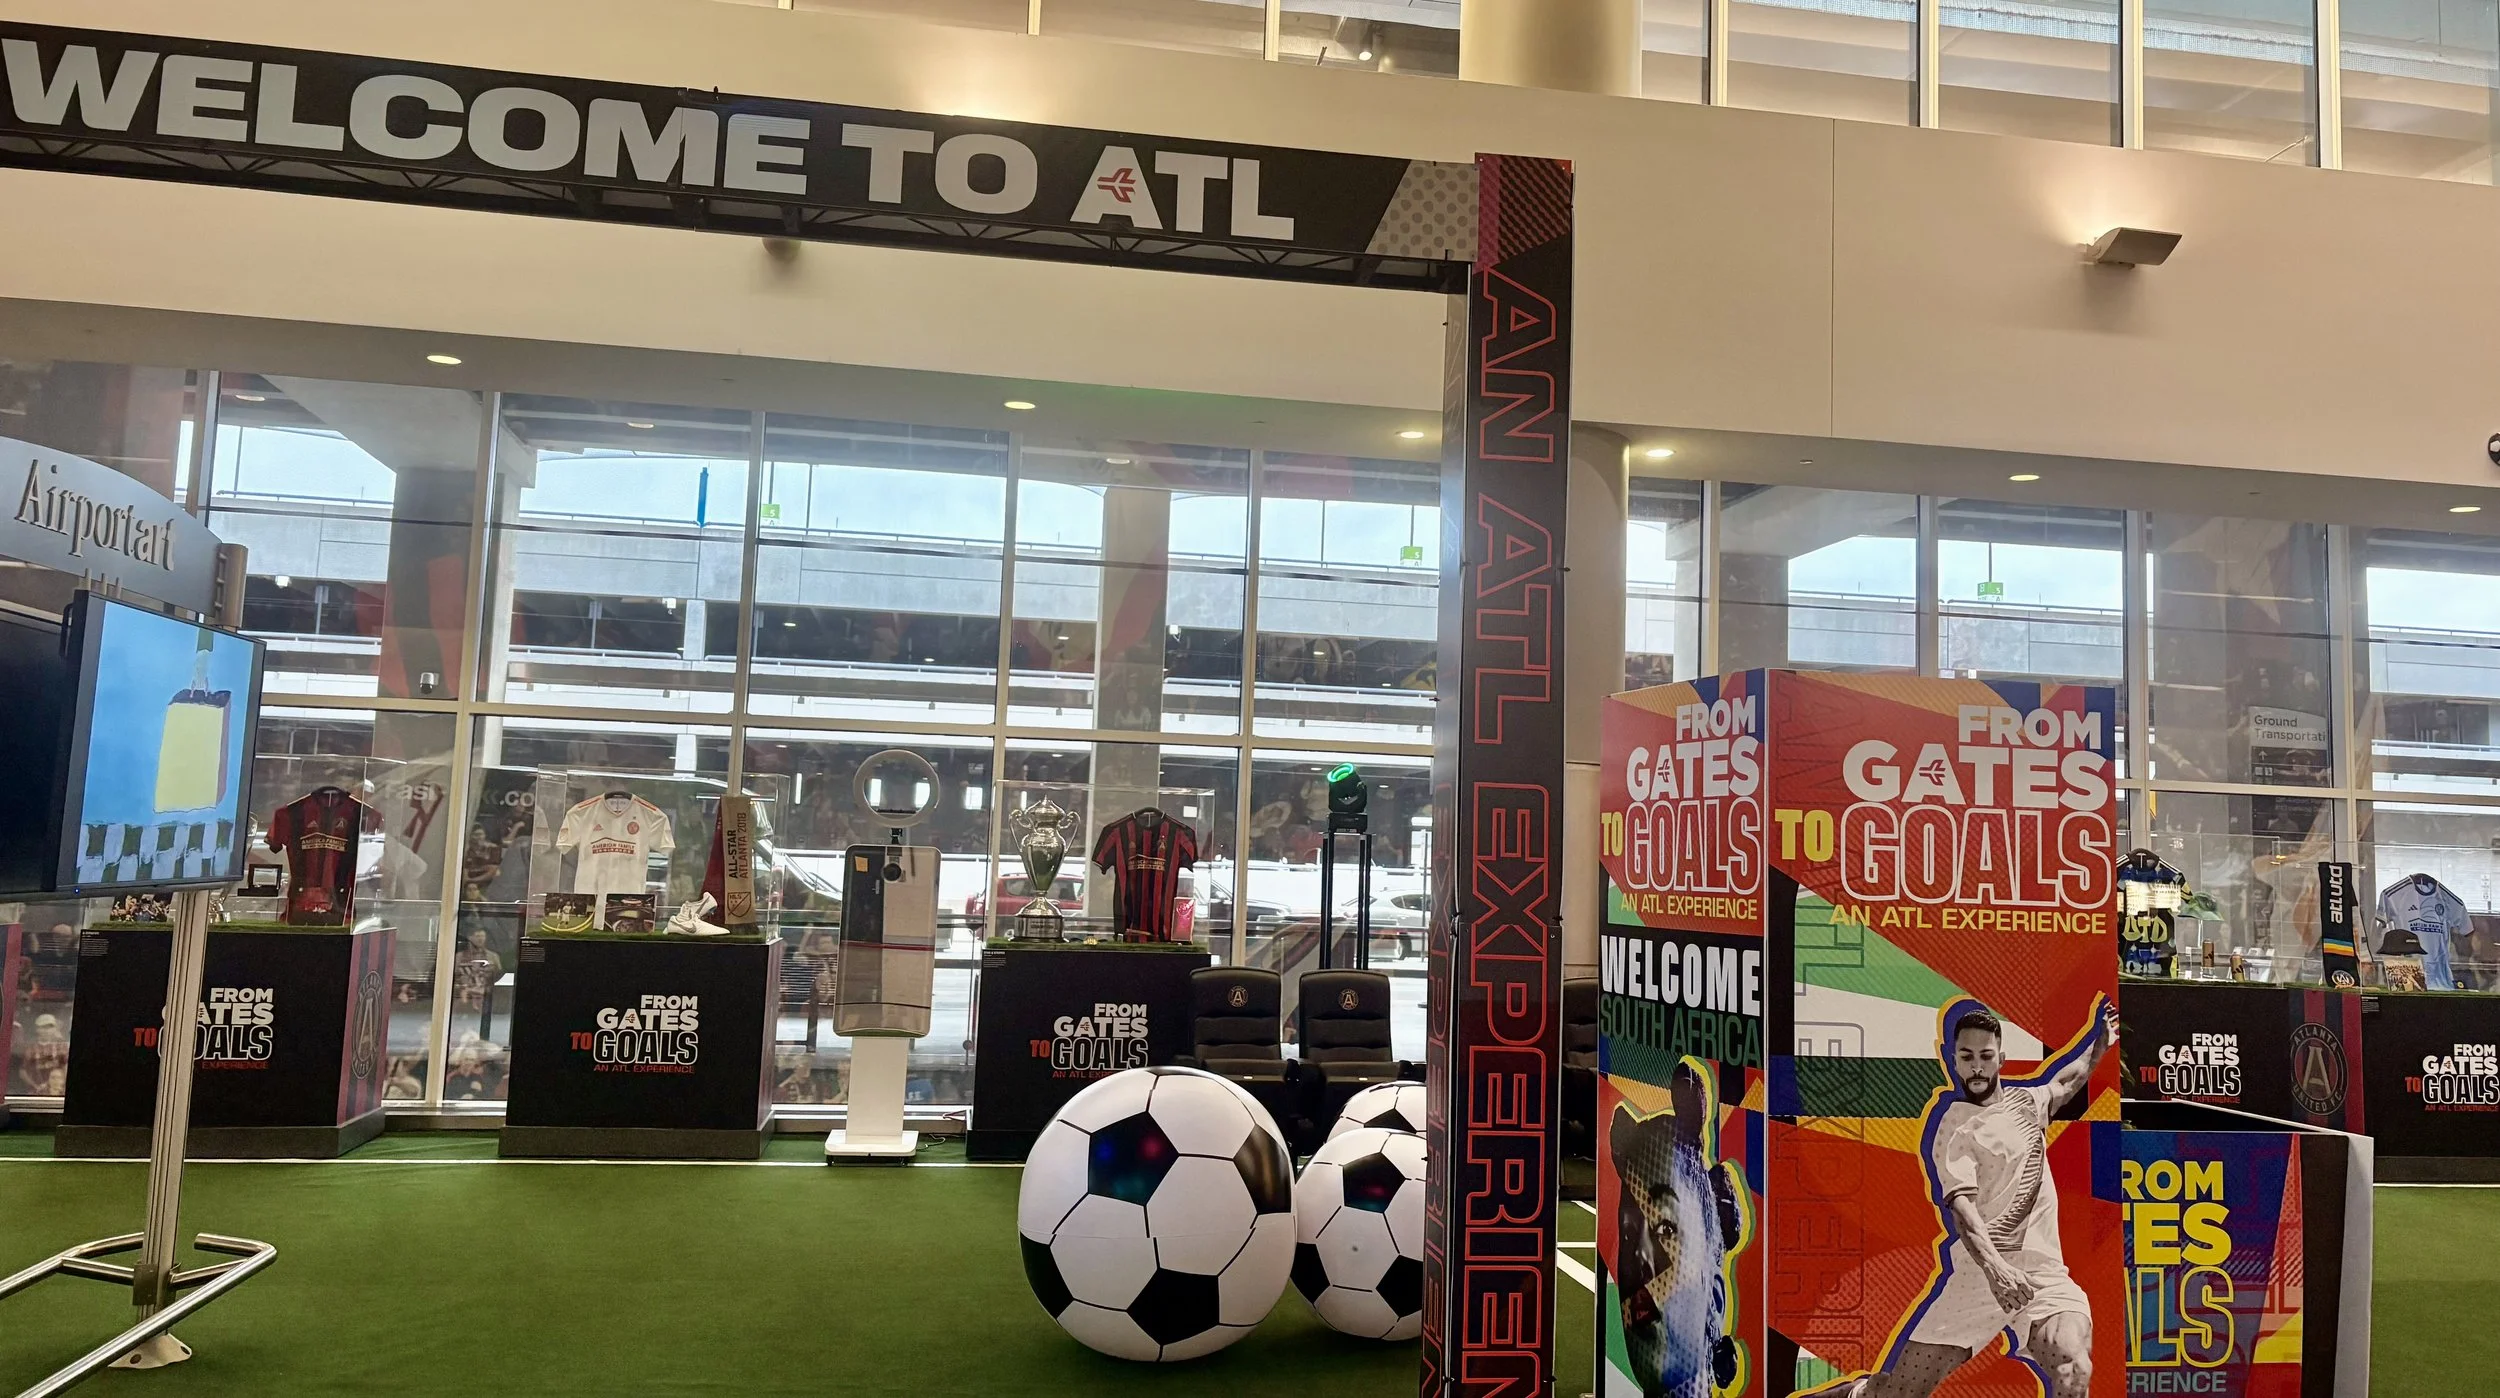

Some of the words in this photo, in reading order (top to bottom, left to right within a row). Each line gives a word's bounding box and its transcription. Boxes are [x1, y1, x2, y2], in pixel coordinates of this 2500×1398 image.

[1, 38, 811, 195] WELCOME
[841, 123, 1038, 213] TO
[1069, 145, 1294, 241] ATL
[1480, 264, 1556, 463] AN
[14, 459, 174, 571] Airportart
[1474, 493, 1552, 745] ATL
[1676, 695, 1756, 741] FROM
[1958, 705, 2101, 749] FROM
[2254, 715, 2298, 728] Ground
[2255, 728, 2326, 742] Transportati
[1626, 735, 1760, 802] GATES
[1842, 740, 2108, 810] GATES
[727, 829, 738, 879] ALL-STAR
[1601, 812, 1623, 857] TO
[1624, 796, 1761, 895] GOALS
[1774, 808, 1834, 862] TO
[1841, 801, 2111, 909] GOALS
[1621, 893, 1638, 912] AN
[1641, 894, 1665, 915] ATL
[1667, 896, 1757, 920] EXPERIENCE
[1829, 904, 1871, 926] AN
[1880, 906, 1930, 929] ATL
[1942, 909, 2106, 934] EXPERIENCE
[1601, 934, 1760, 1017] WELCOME
[210, 988, 274, 1003] FROM
[640, 994, 698, 1009] FROM
[1094, 1003, 1147, 1017] FROM
[162, 1002, 274, 1025] ATES
[596, 1007, 699, 1031] GATES
[1053, 1016, 1148, 1037] GATES
[133, 1027, 157, 1047] TO
[1600, 992, 1664, 1046] SOUTH
[1669, 1008, 1761, 1067] AFRICA
[2192, 1033, 2238, 1046] FROM
[570, 1032, 592, 1050] TO
[593, 1029, 698, 1065] GOALS
[1030, 1040, 1050, 1057] TO
[1051, 1037, 1148, 1070] GOALS
[2158, 1044, 2240, 1066] GATES
[2453, 1044, 2496, 1057] FROM
[612, 1064, 631, 1072] ATL
[633, 1065, 695, 1073] EXPERIENCE
[2140, 1067, 2157, 1082] TO
[2158, 1063, 2241, 1096] GOALS
[2422, 1055, 2499, 1075] GATES
[2405, 1077, 2421, 1093] TO
[2422, 1074, 2500, 1105] GOALS
[2121, 1159, 2224, 1201] ROM
[2126, 1371, 2227, 1393] RIENCE
